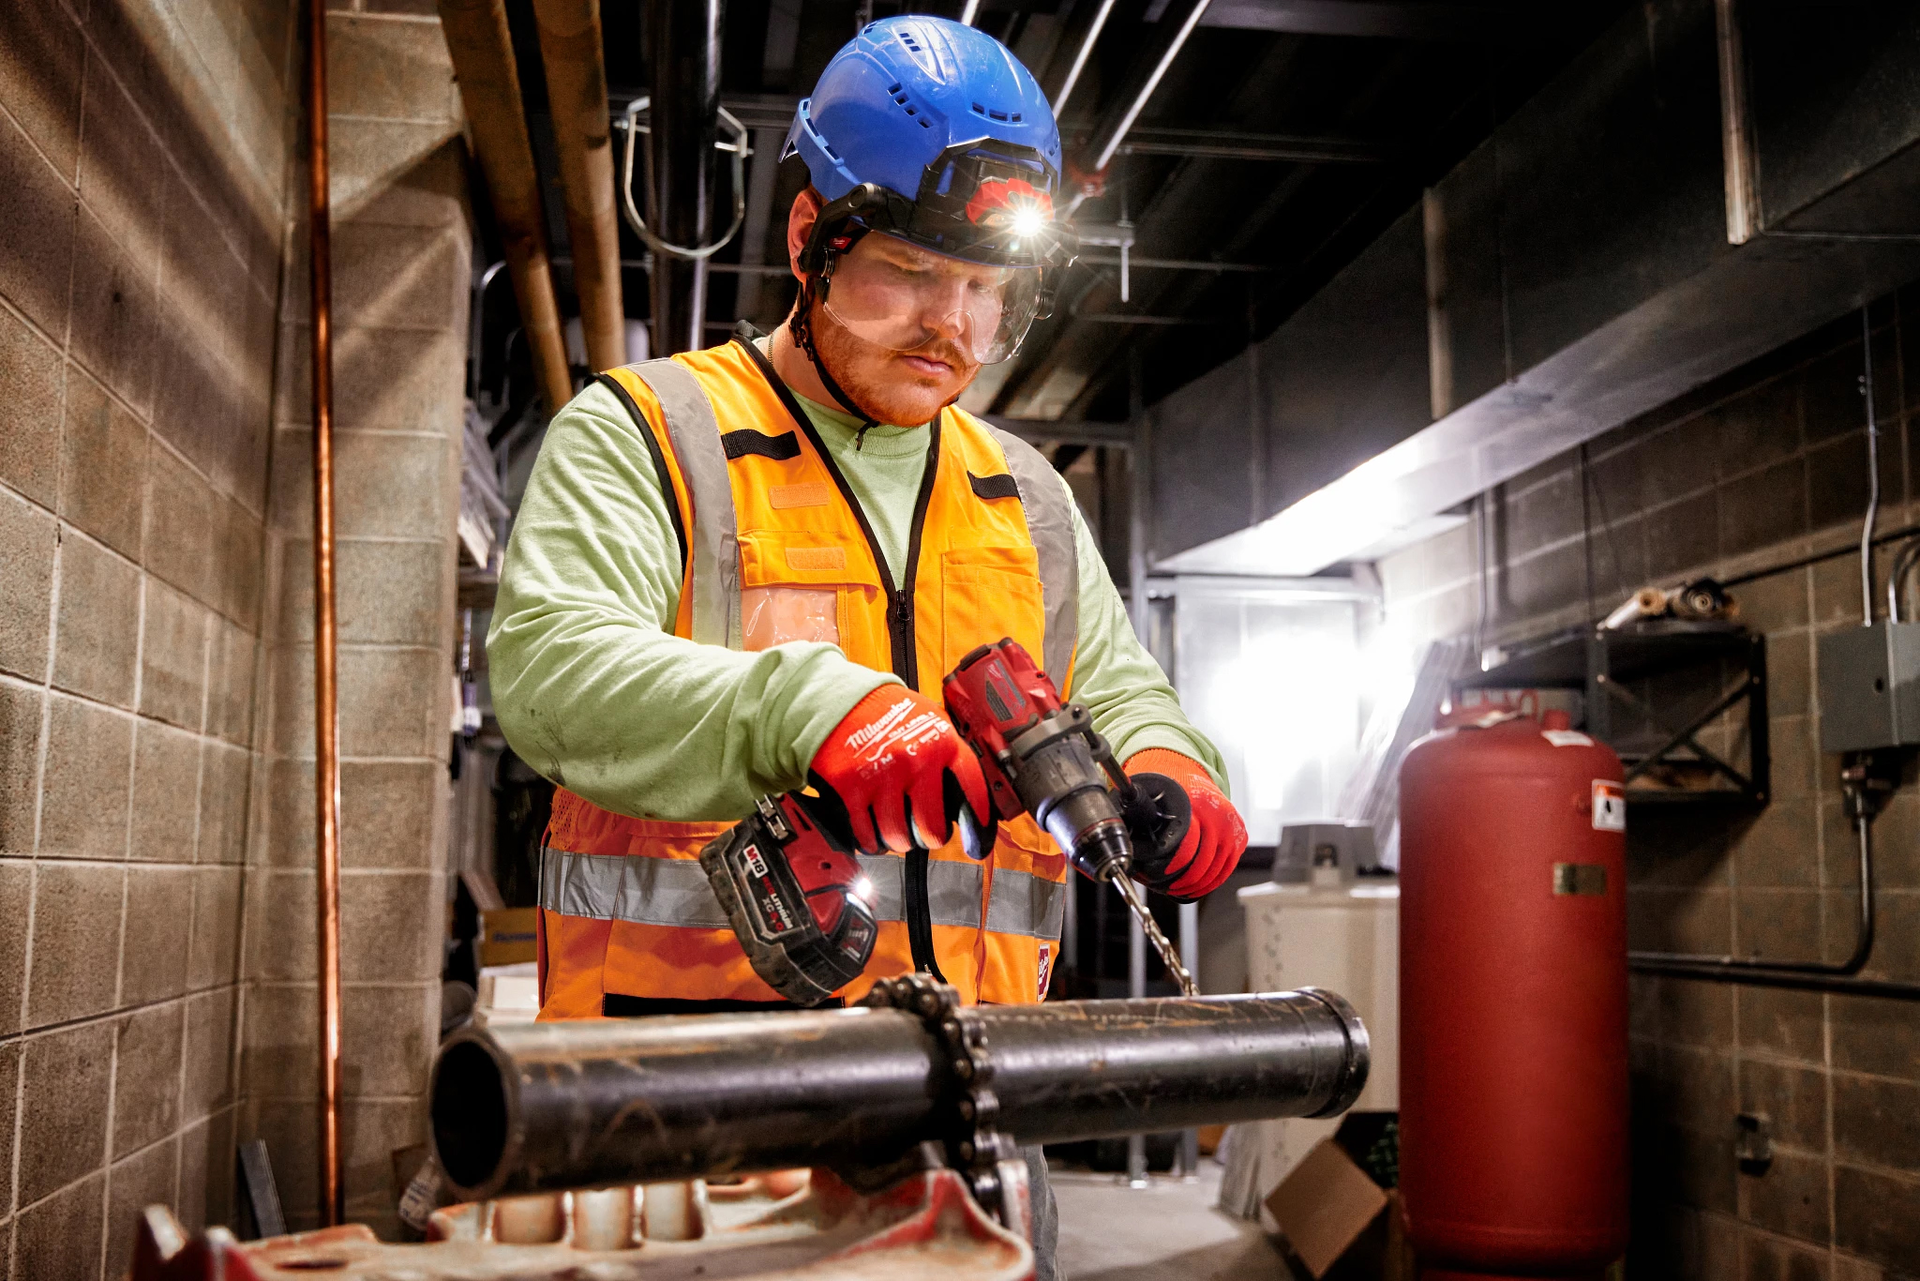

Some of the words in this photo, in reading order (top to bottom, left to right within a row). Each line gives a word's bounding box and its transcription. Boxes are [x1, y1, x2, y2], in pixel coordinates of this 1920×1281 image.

[844, 698, 912, 751] Milwaukee
[746, 846, 765, 875] M18
[762, 876, 794, 930] REDLITHIUM
